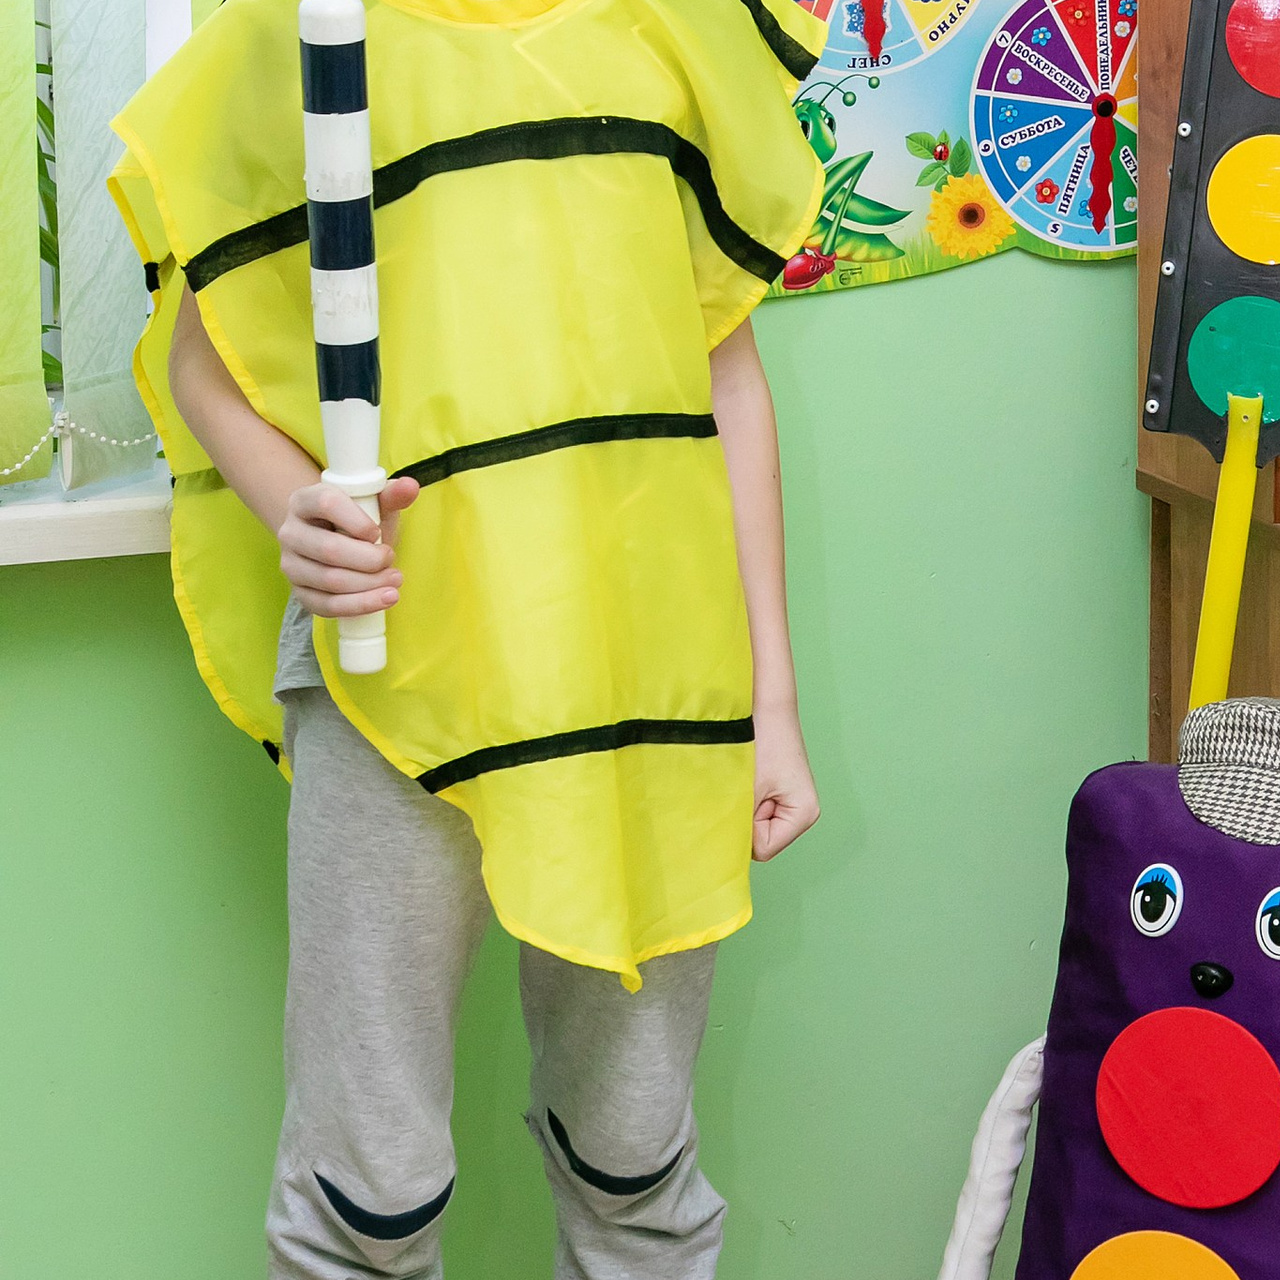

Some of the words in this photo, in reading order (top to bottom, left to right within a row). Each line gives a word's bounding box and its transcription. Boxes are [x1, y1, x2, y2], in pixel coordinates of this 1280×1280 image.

[847, 53, 892, 70] СНЕГ
[1013, 43, 1089, 101] ВОСКРЕСЕНЬЕ
[1000, 116, 1063, 147] СУББОТА
[1057, 144, 1091, 215] ПЯТНИЦА
